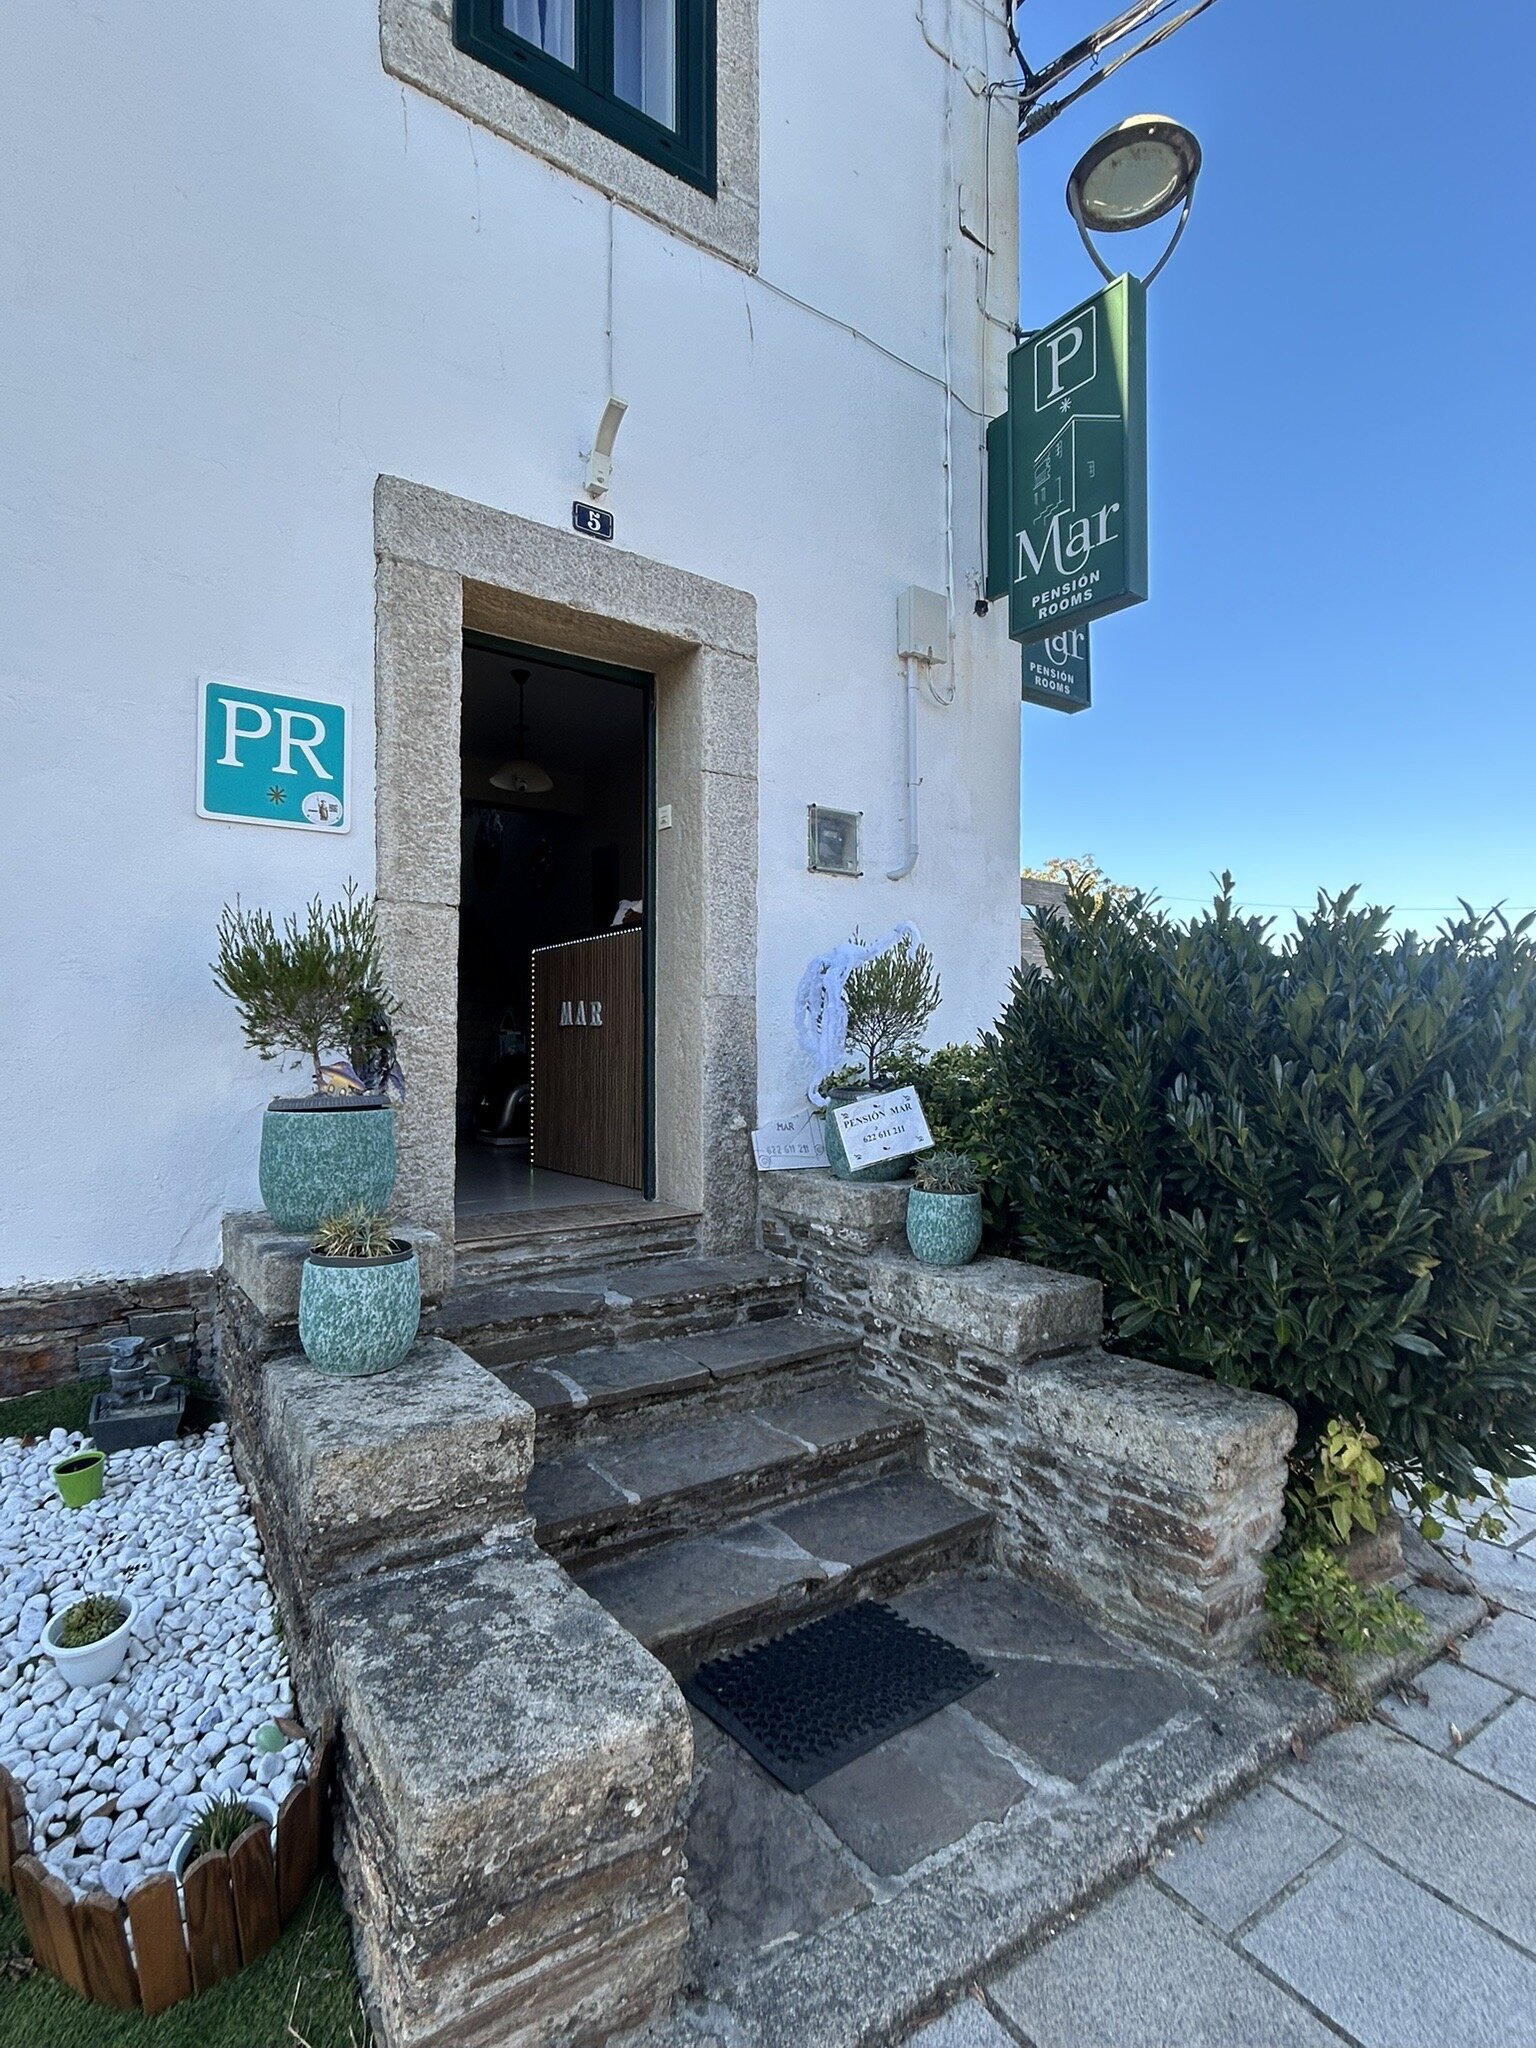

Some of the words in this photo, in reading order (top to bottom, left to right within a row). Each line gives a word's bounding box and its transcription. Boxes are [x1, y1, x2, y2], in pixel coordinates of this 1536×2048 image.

[1046, 326, 1083, 399] P
[587, 510, 601, 531] 5
[1014, 502, 1119, 583] Mar
[1032, 570, 1100, 608] PENSIÓN
[1038, 588, 1093, 620] ROOMS
[1030, 661, 1074, 684] PENSIÓN
[1035, 675, 1070, 695] ROOMS
[216, 698, 334, 780] PR
[560, 1000, 603, 1026] MAR
[776, 1121, 795, 1131] MAR
[843, 1109, 886, 1129] PENSIÓN
[890, 1102, 912, 1116] MAR
[863, 1133, 877, 1143] 622
[878, 1129, 891, 1139] 611
[893, 1125, 905, 1135] 211
